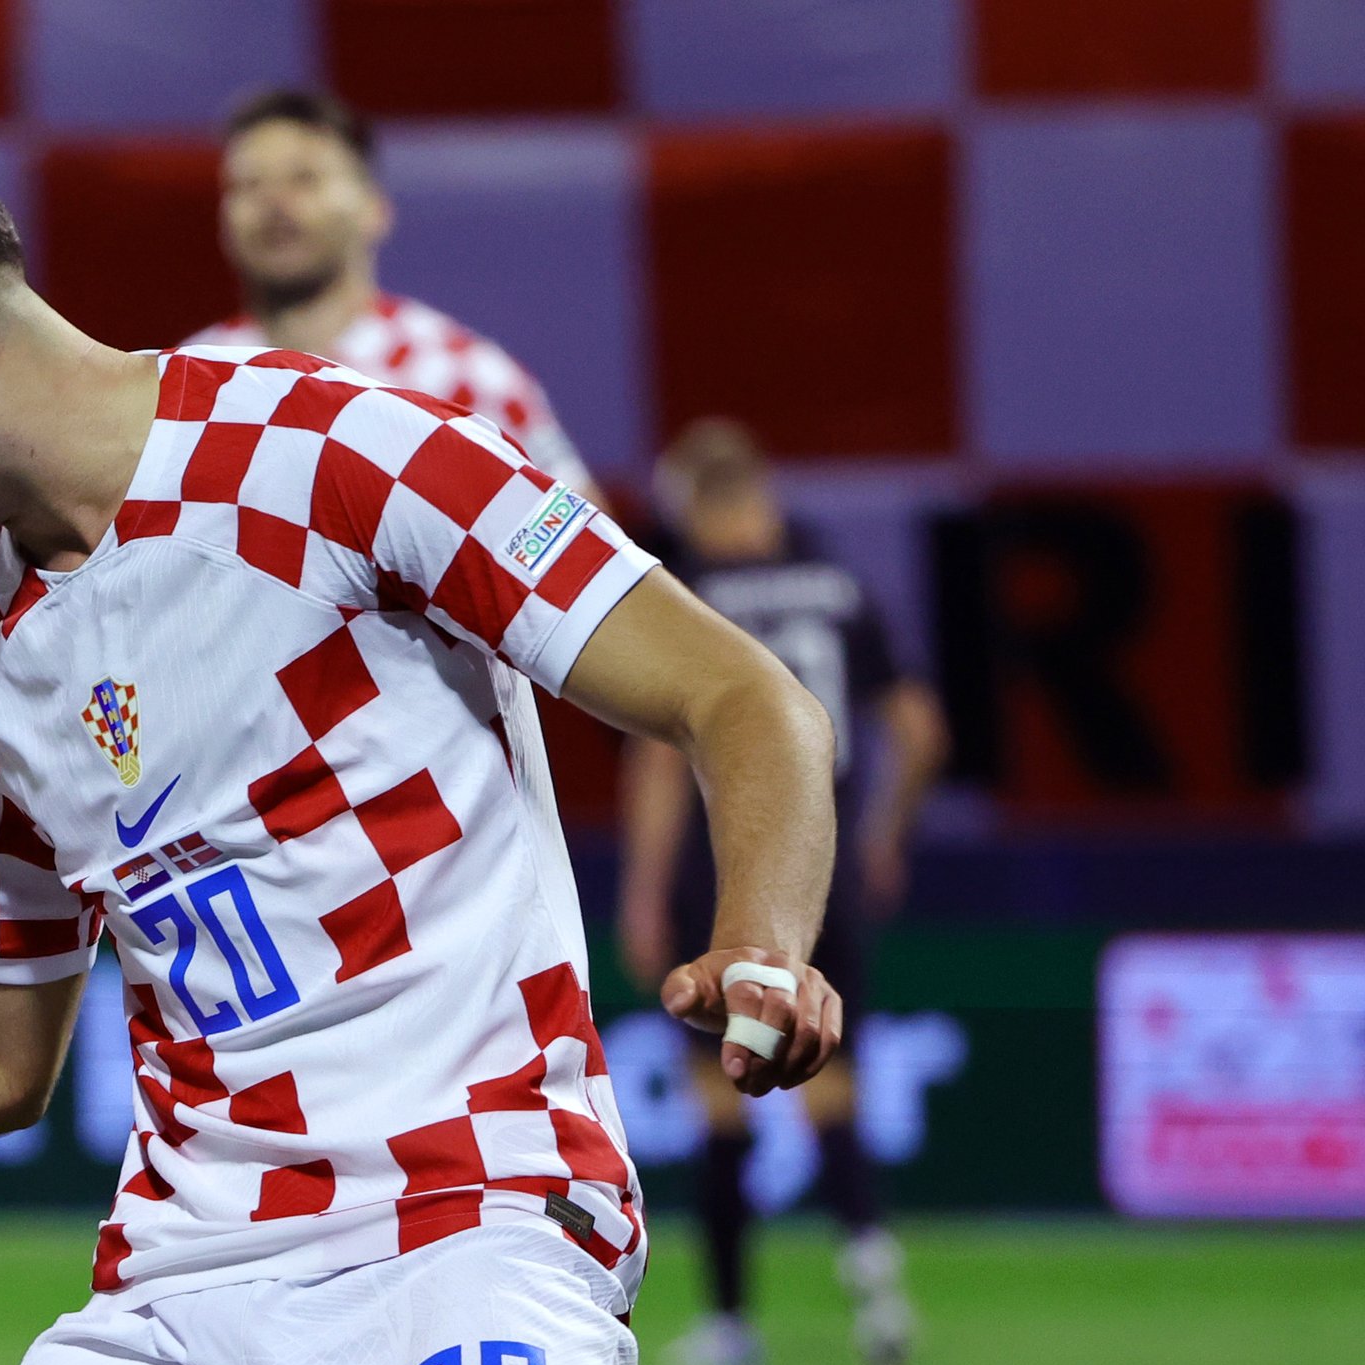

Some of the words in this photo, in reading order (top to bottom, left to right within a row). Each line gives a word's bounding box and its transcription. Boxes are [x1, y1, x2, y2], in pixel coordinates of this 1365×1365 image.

[504, 527, 530, 556] UEFA
[514, 493, 582, 567] FOUNDA
[100, 688, 125, 745] HNS
[129, 864, 301, 1037] 20
